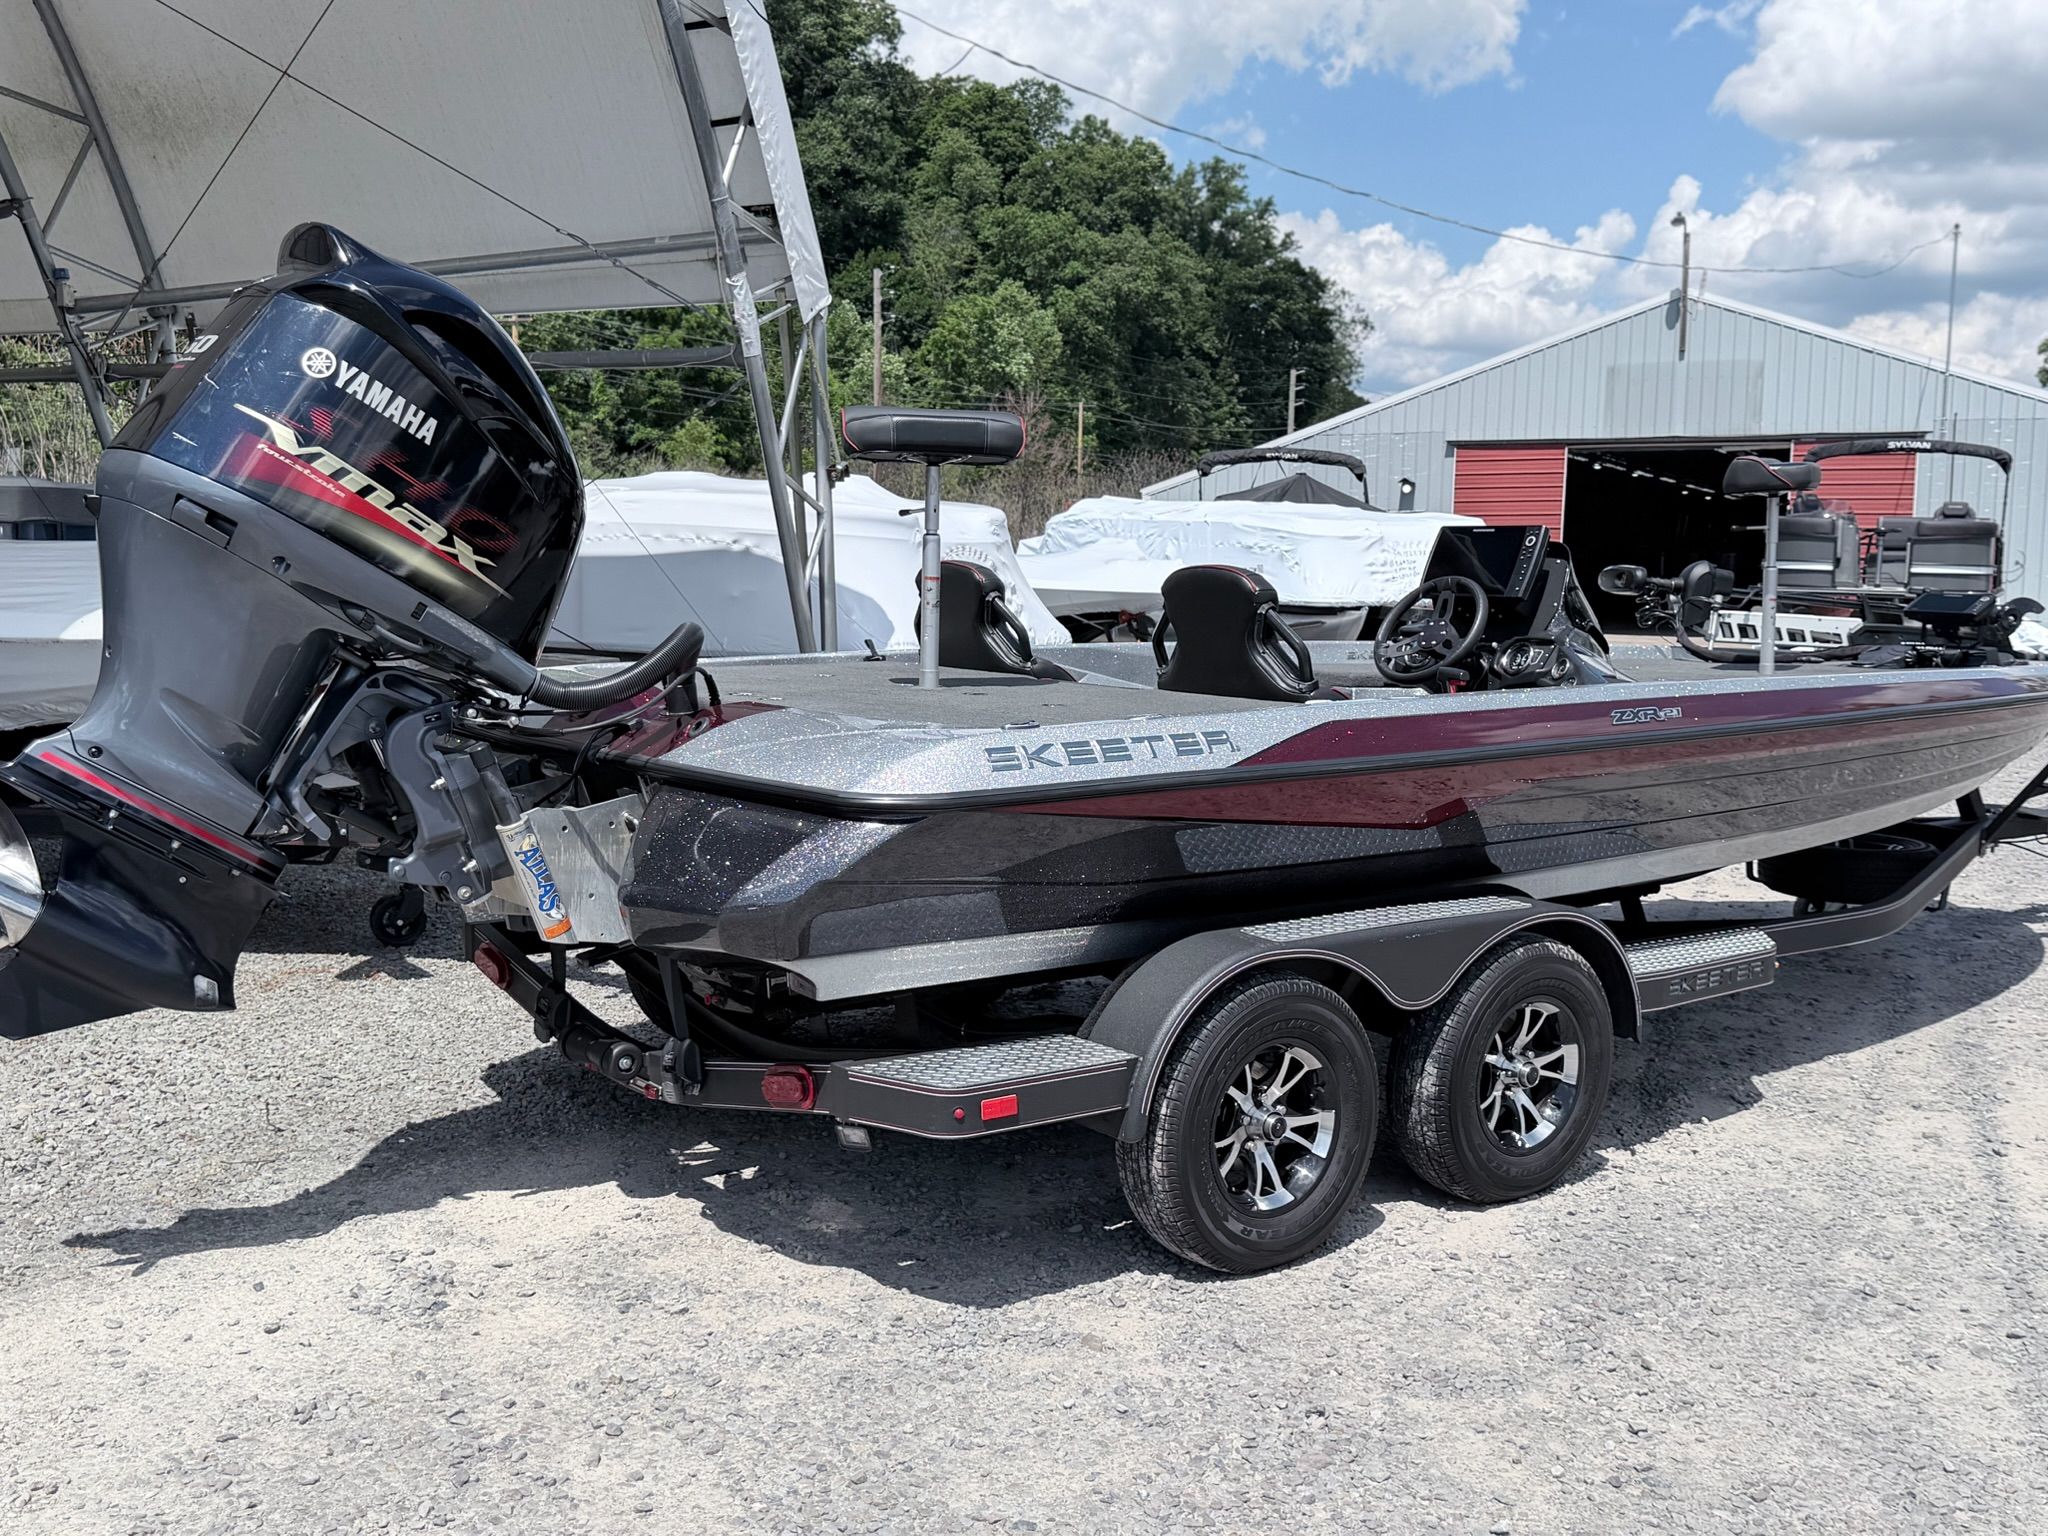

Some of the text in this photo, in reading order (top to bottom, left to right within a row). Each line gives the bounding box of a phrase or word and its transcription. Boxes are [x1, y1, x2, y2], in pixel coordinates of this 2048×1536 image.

[334, 360, 438, 446] YAMAHA
[1265, 452, 1299, 460] SYVAN
[1887, 441, 1931, 449] SYLVAN
[985, 730, 1237, 773] SKEETER
[514, 846, 560, 912] ATLAS
[1669, 962, 1766, 996] SKEETER
